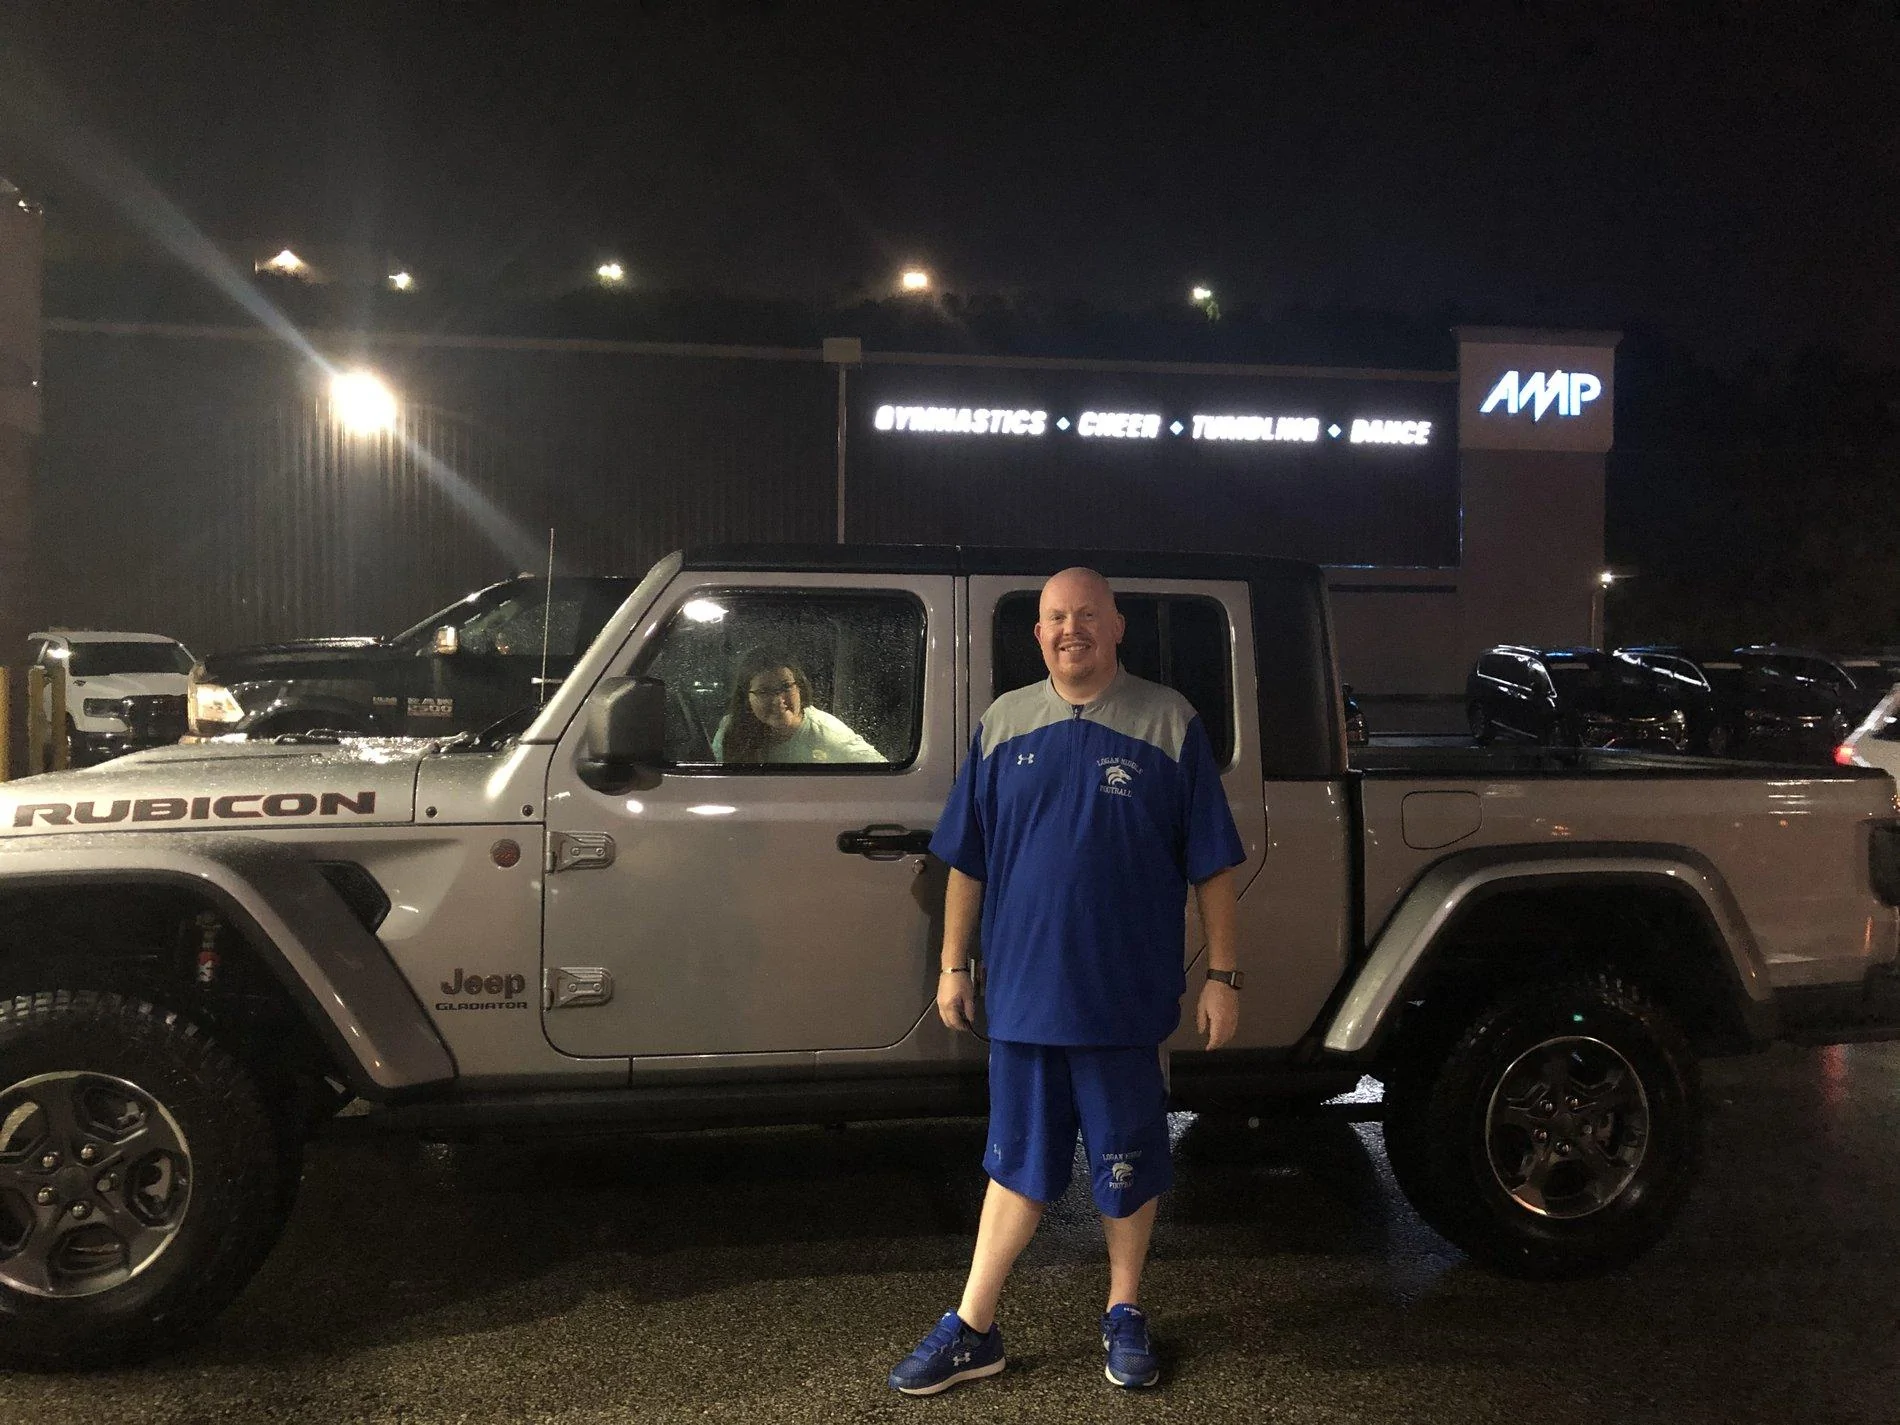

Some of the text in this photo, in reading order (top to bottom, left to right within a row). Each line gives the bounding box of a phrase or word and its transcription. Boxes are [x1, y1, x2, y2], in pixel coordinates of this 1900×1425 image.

[1480, 369, 1602, 422] AMP
[874, 404, 1432, 445] GYMNASTICS CHEER TUMBLING DANCE
[1096, 757, 1120, 766] LOGAN
[12, 791, 376, 828] RUBICON
[440, 967, 526, 999] Jeep
[435, 1001, 529, 1011] GLADIATOR
